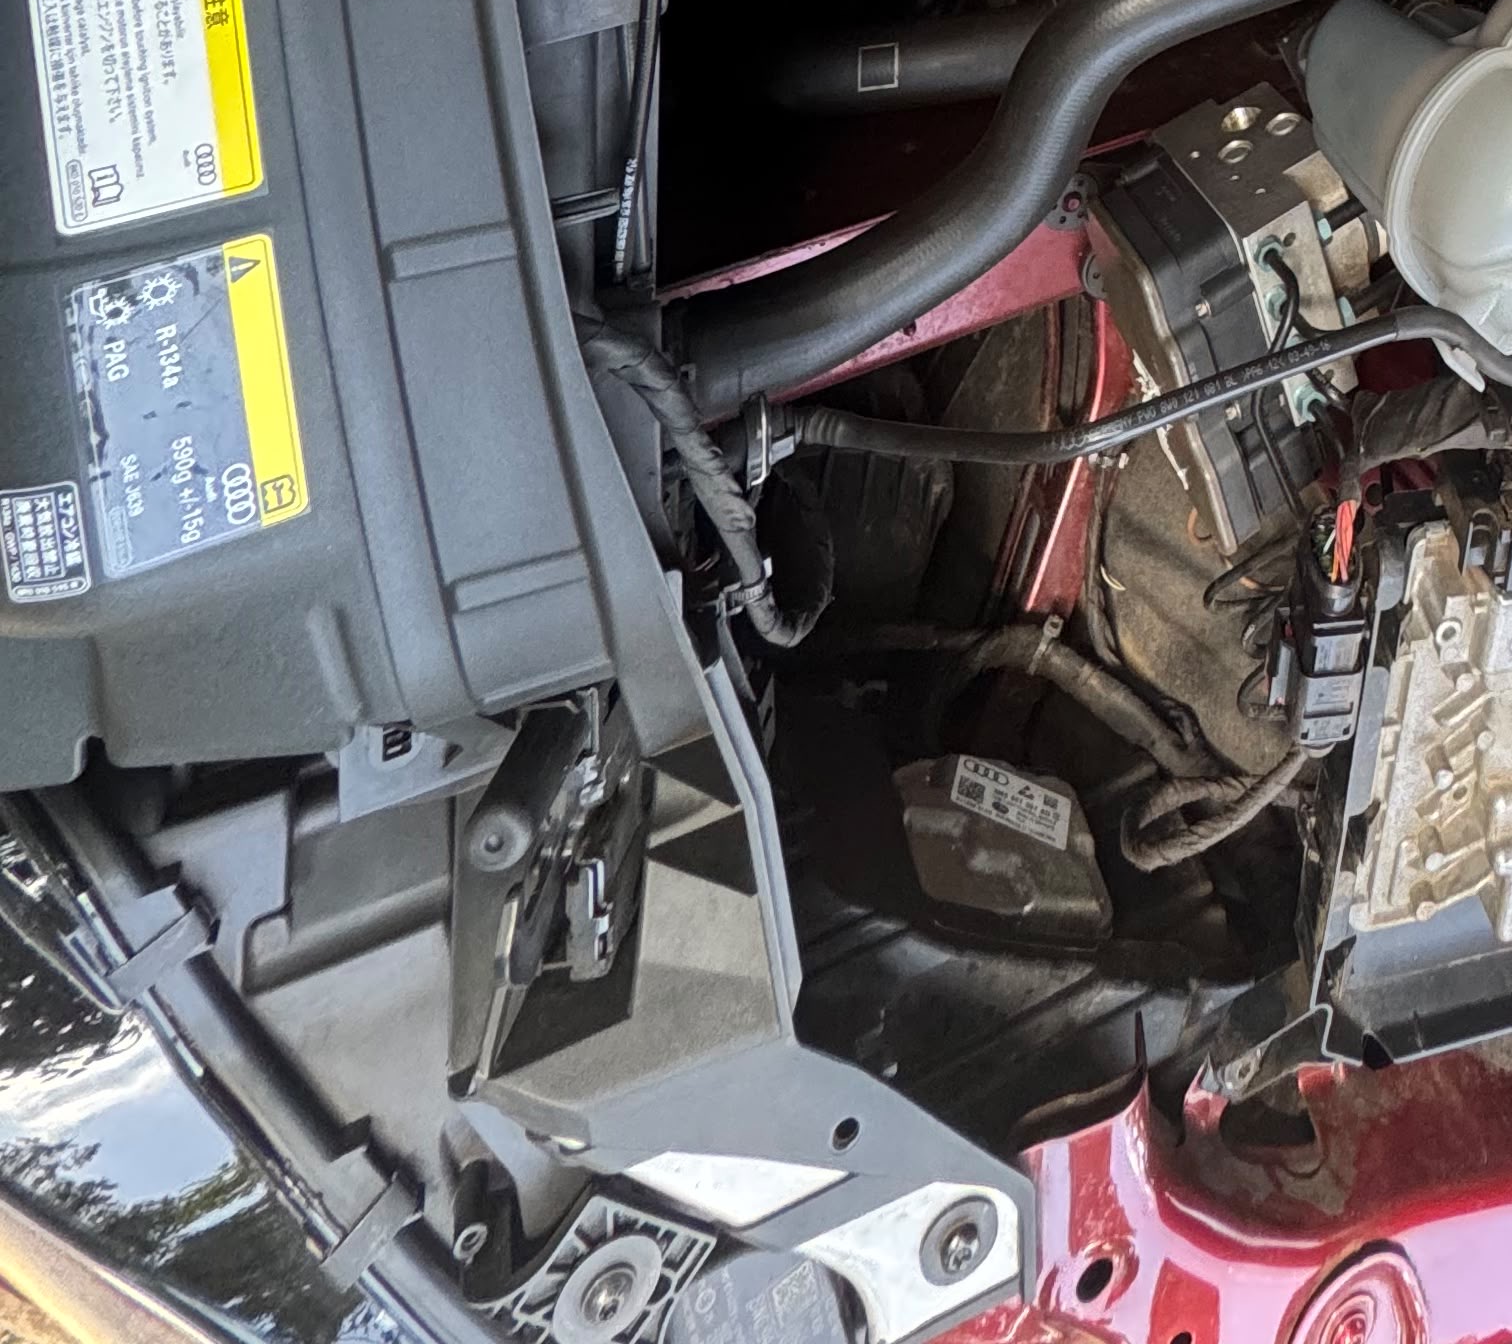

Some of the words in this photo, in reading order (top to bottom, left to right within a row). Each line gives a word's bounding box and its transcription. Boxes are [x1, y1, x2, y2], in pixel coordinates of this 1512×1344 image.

[132, 29, 149, 71] touching
[137, 71, 154, 108] ignition
[102, 339, 130, 382] PAG
[152, 322, 185, 389] R-134a
[118, 453, 141, 483] SAE
[166, 435, 196, 484] 590g
[123, 483, 145, 518] J639
